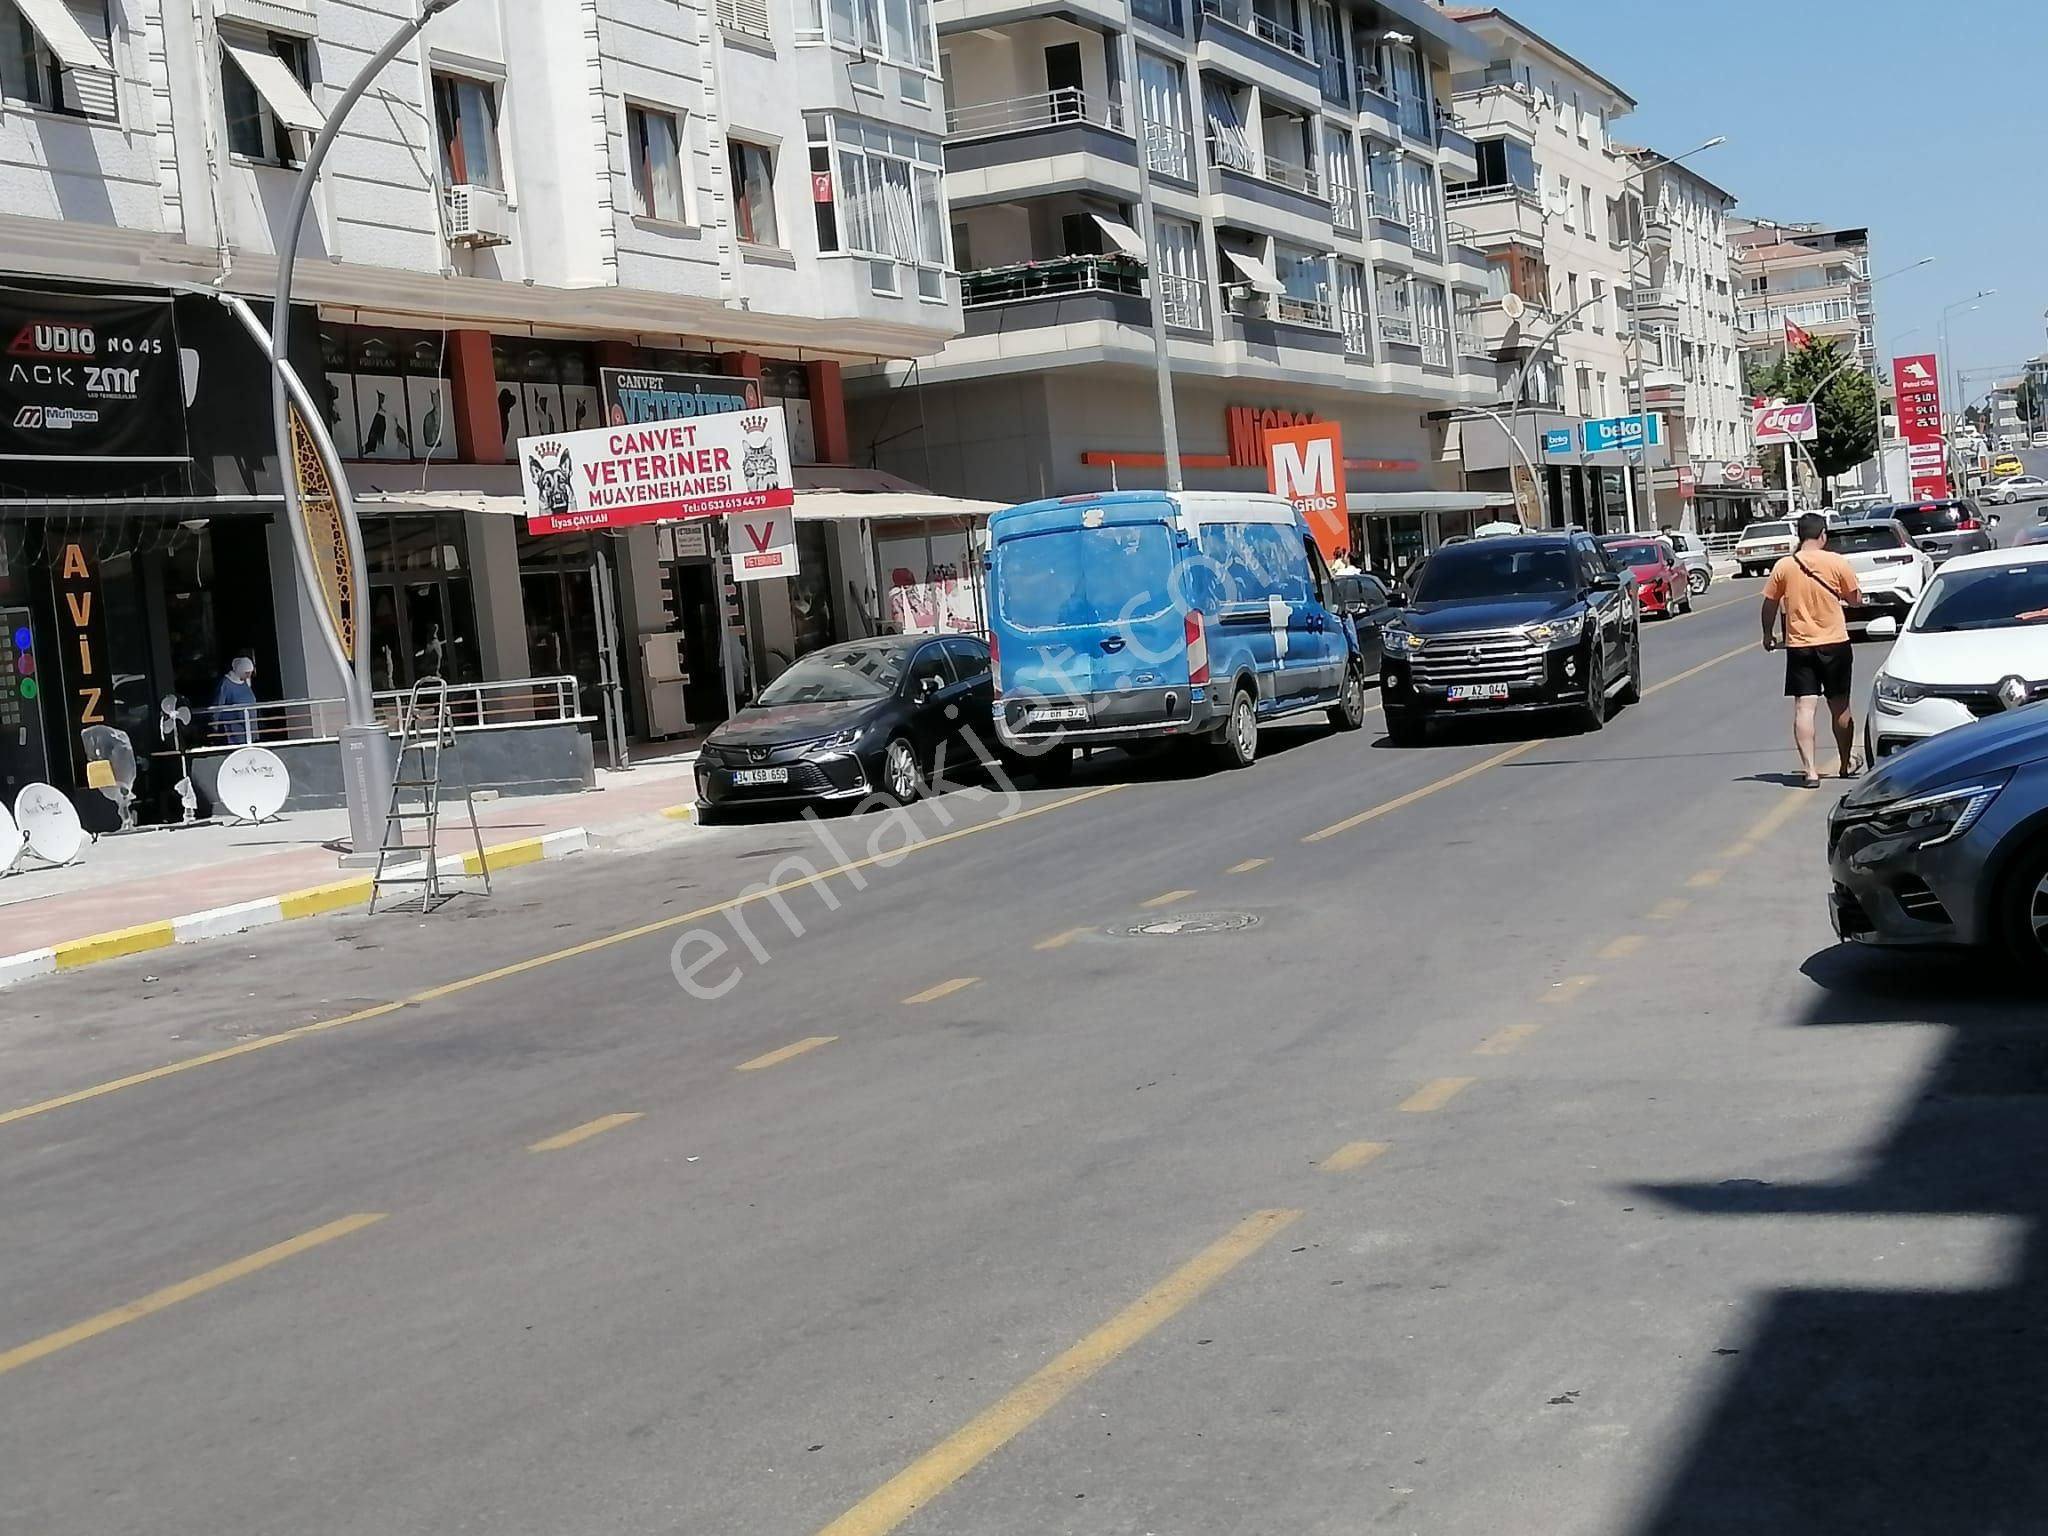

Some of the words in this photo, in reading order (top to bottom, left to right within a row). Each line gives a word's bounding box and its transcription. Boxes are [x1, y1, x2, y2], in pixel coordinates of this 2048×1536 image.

[9, 325, 96, 354] AUDIO
[617, 375, 664, 390] CANVET
[46, 407, 98, 421] Mutlusan
[1764, 413, 1802, 431] dyo
[1600, 422, 1641, 438] beko
[609, 425, 697, 455] CANVET
[708, 499, 725, 511] 533
[726, 497, 742, 508] 613
[744, 521, 774, 553] V
[1452, 684, 1464, 697] 77
[1488, 682, 1506, 695] 044
[737, 771, 748, 782] 34
[771, 769, 786, 780] 659
